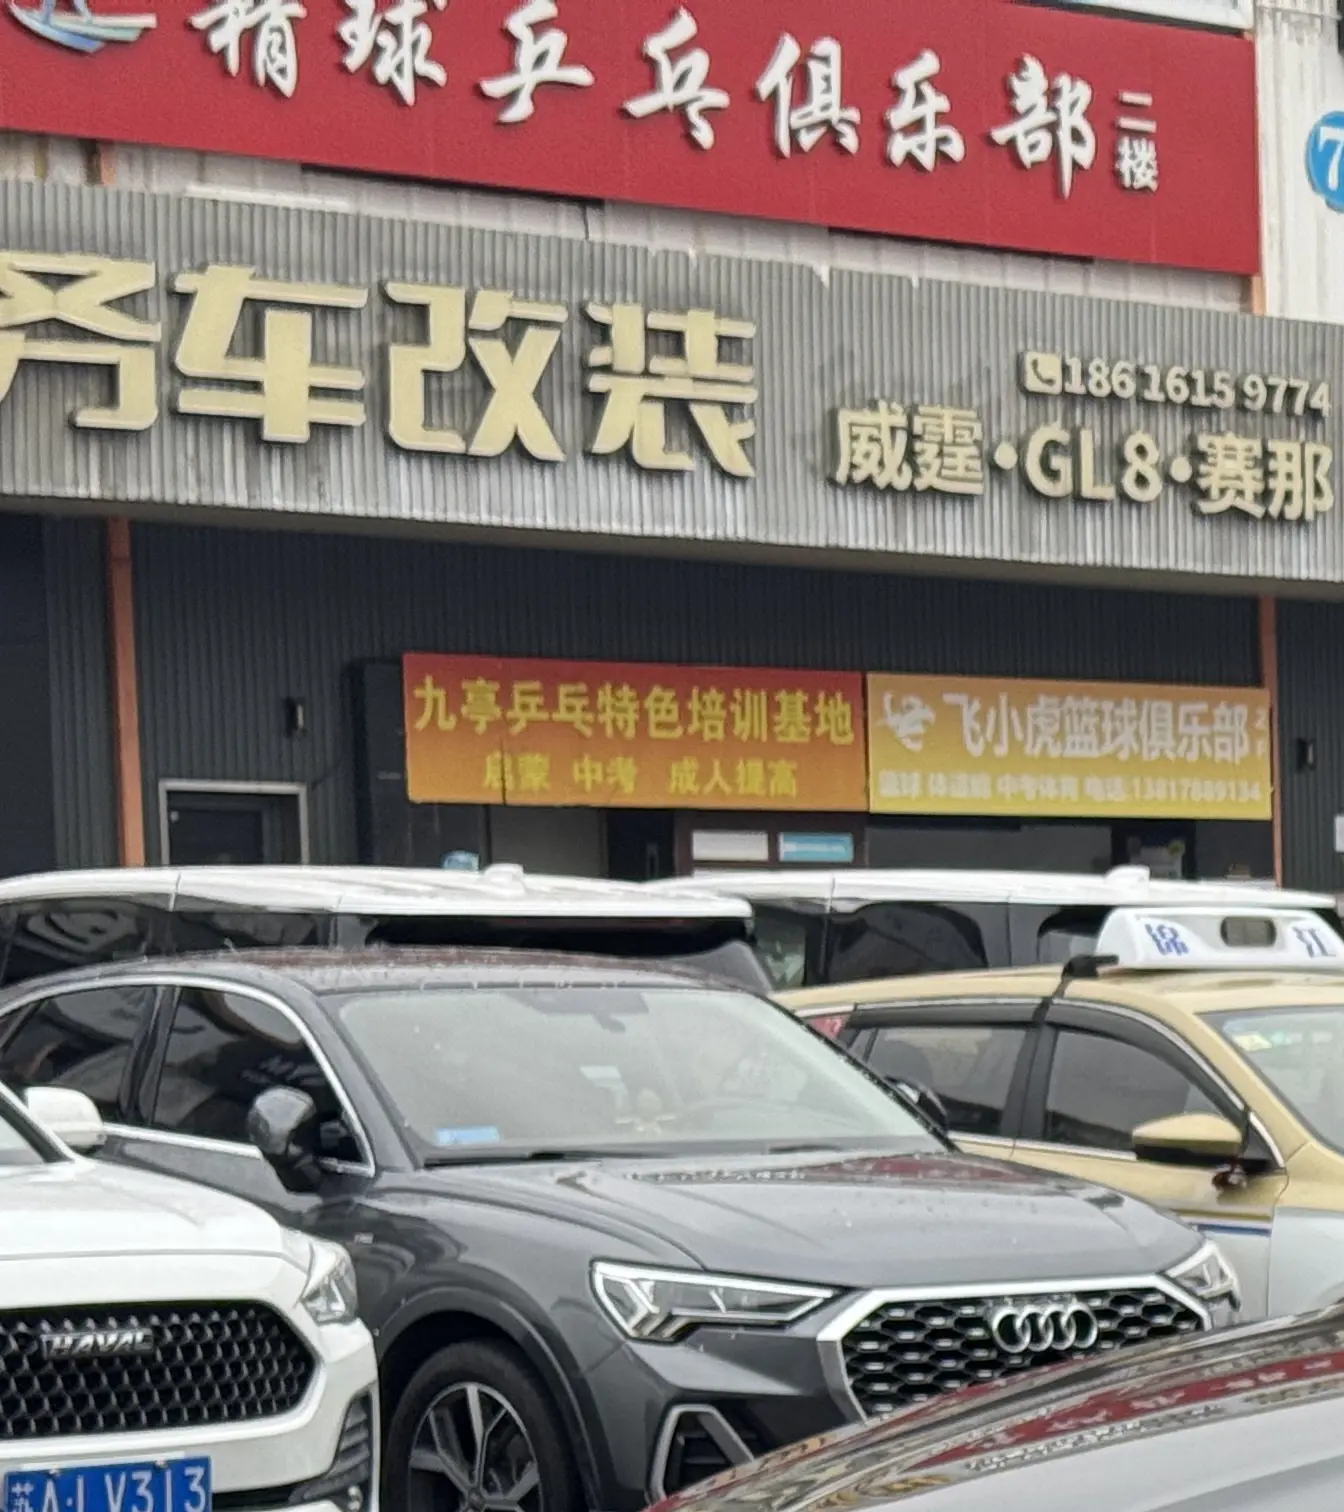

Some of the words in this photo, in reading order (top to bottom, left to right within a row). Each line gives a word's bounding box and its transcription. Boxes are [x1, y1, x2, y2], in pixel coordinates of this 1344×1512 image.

[1115, 92, 1159, 193] 二楼
[0, 252, 757, 478] 务车改装
[413, 674, 855, 745] 九亭乒乓特色培训基地
[943, 692, 1250, 764] 飞小虎篮球俱乐部
[572, 753, 638, 795] 中考
[668, 756, 799, 797] 成人提高
